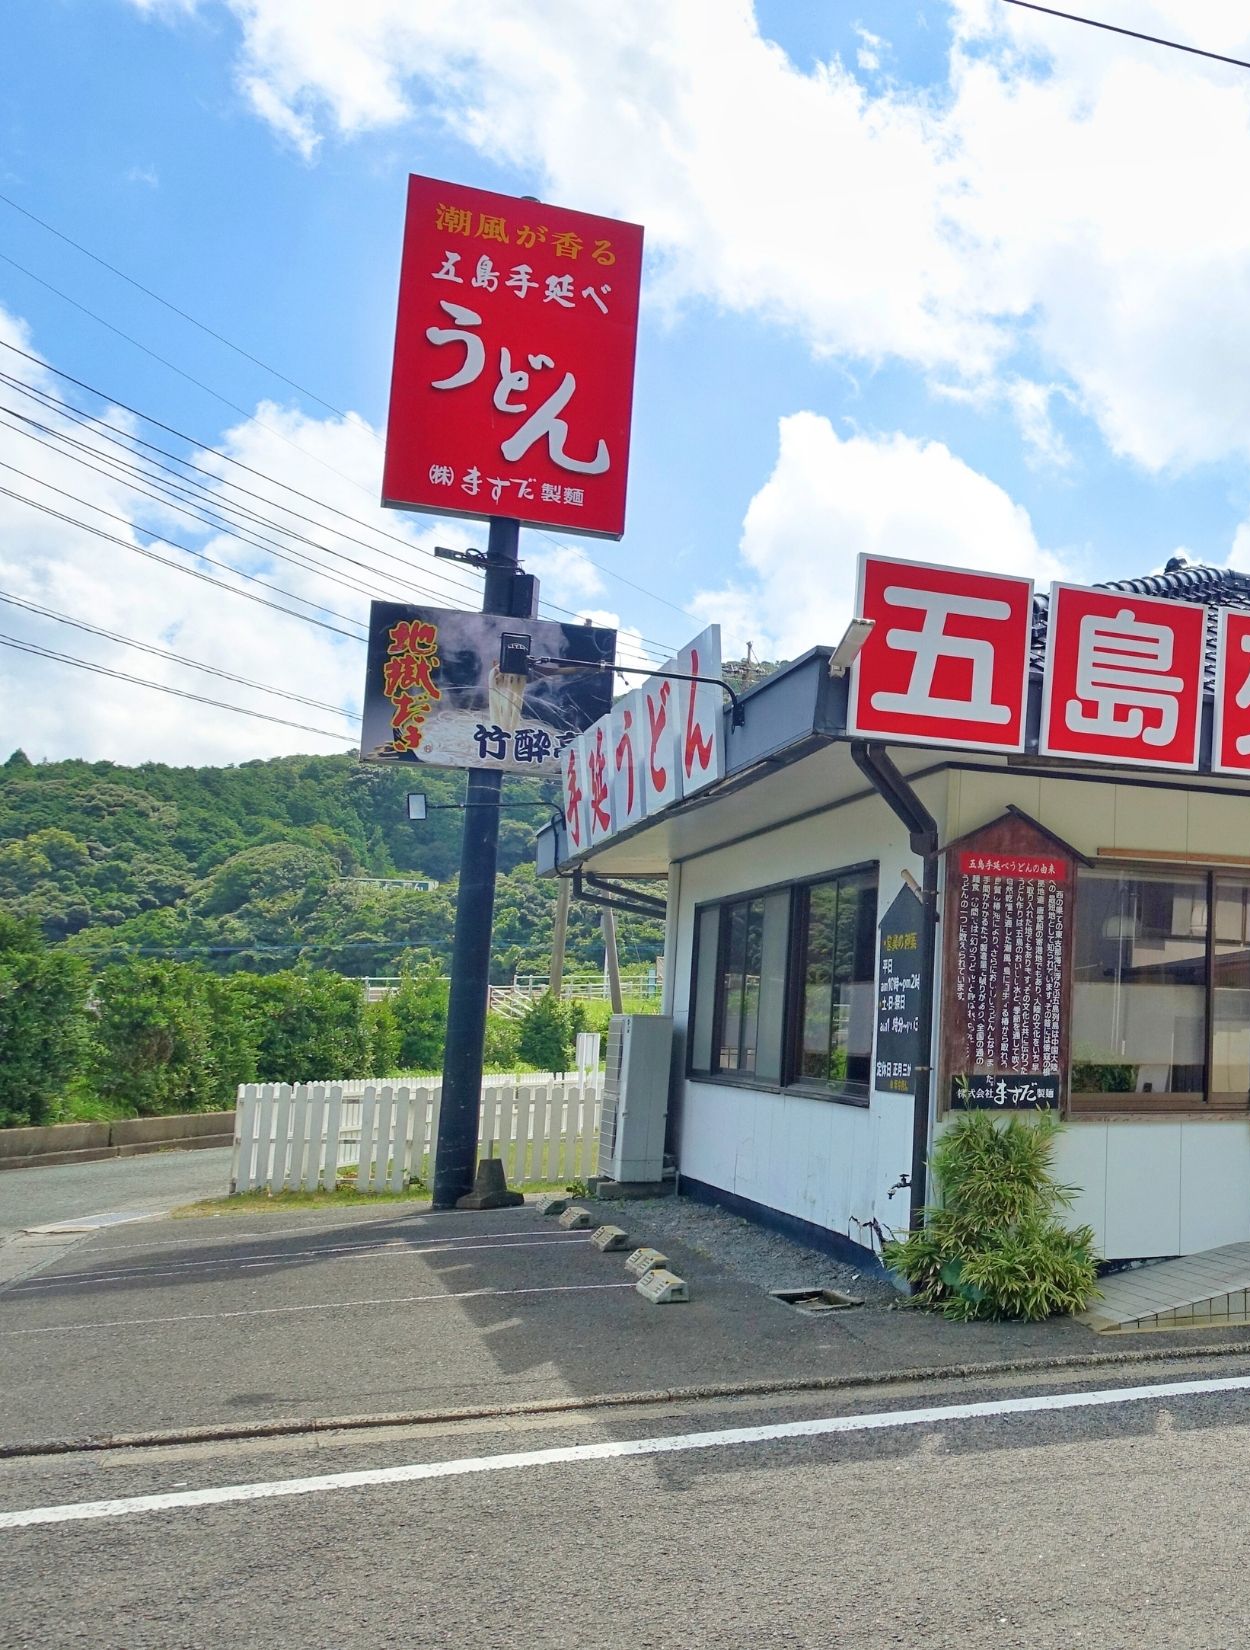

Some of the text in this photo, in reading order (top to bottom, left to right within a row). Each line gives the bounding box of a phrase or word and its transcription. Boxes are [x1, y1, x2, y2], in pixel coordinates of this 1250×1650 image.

[436, 203, 616, 266] 潮風が香る
[431, 251, 612, 314] 五島手延べ
[425, 300, 611, 475] うどん
[968, 858, 1056, 874] 五島手延べうどんの由来
[882, 958, 893, 975] 平日
